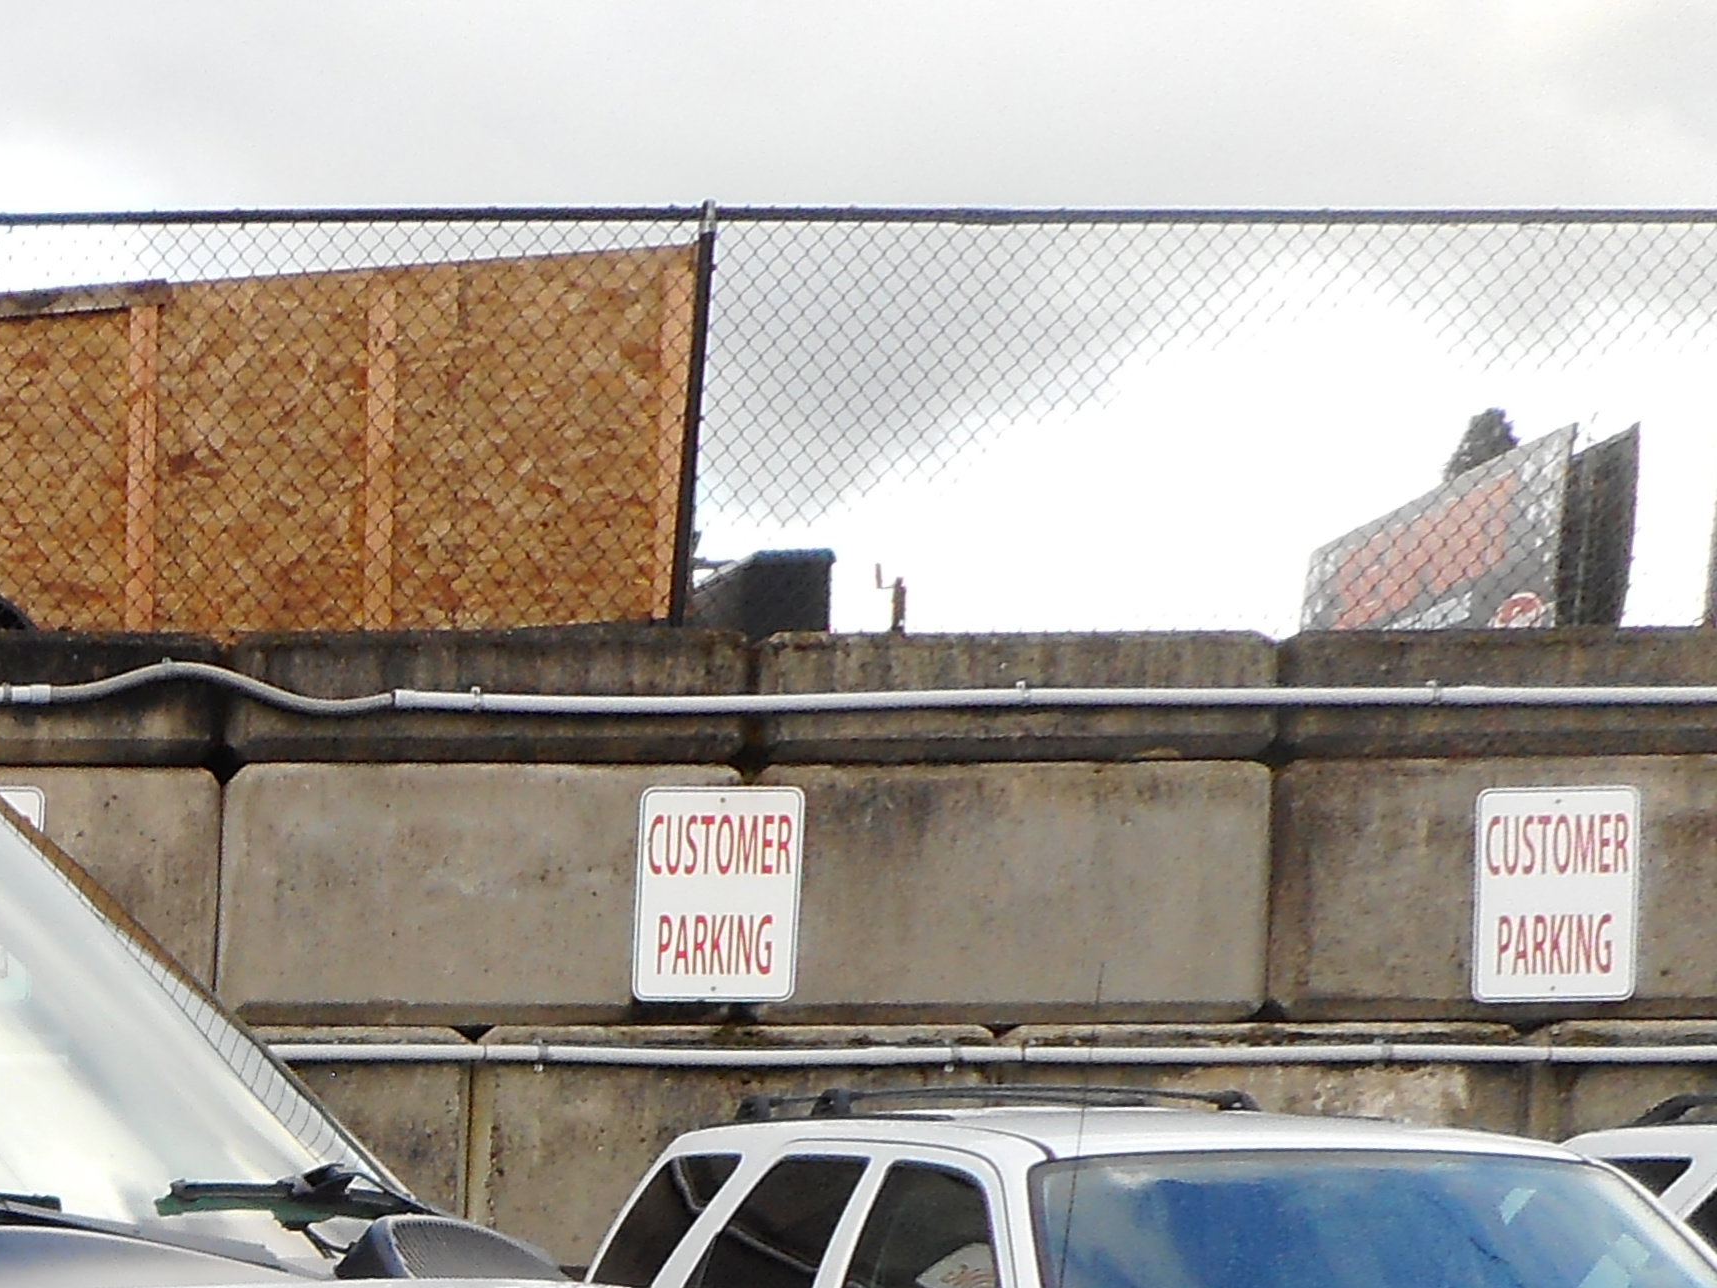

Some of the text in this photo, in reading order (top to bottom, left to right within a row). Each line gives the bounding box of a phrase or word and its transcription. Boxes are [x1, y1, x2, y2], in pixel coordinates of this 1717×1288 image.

[648, 814, 793, 875] CUSTOMER
[1486, 813, 1629, 875] CUSTOMER
[656, 914, 773, 975] PARKING
[1496, 913, 1612, 975] PARKING
